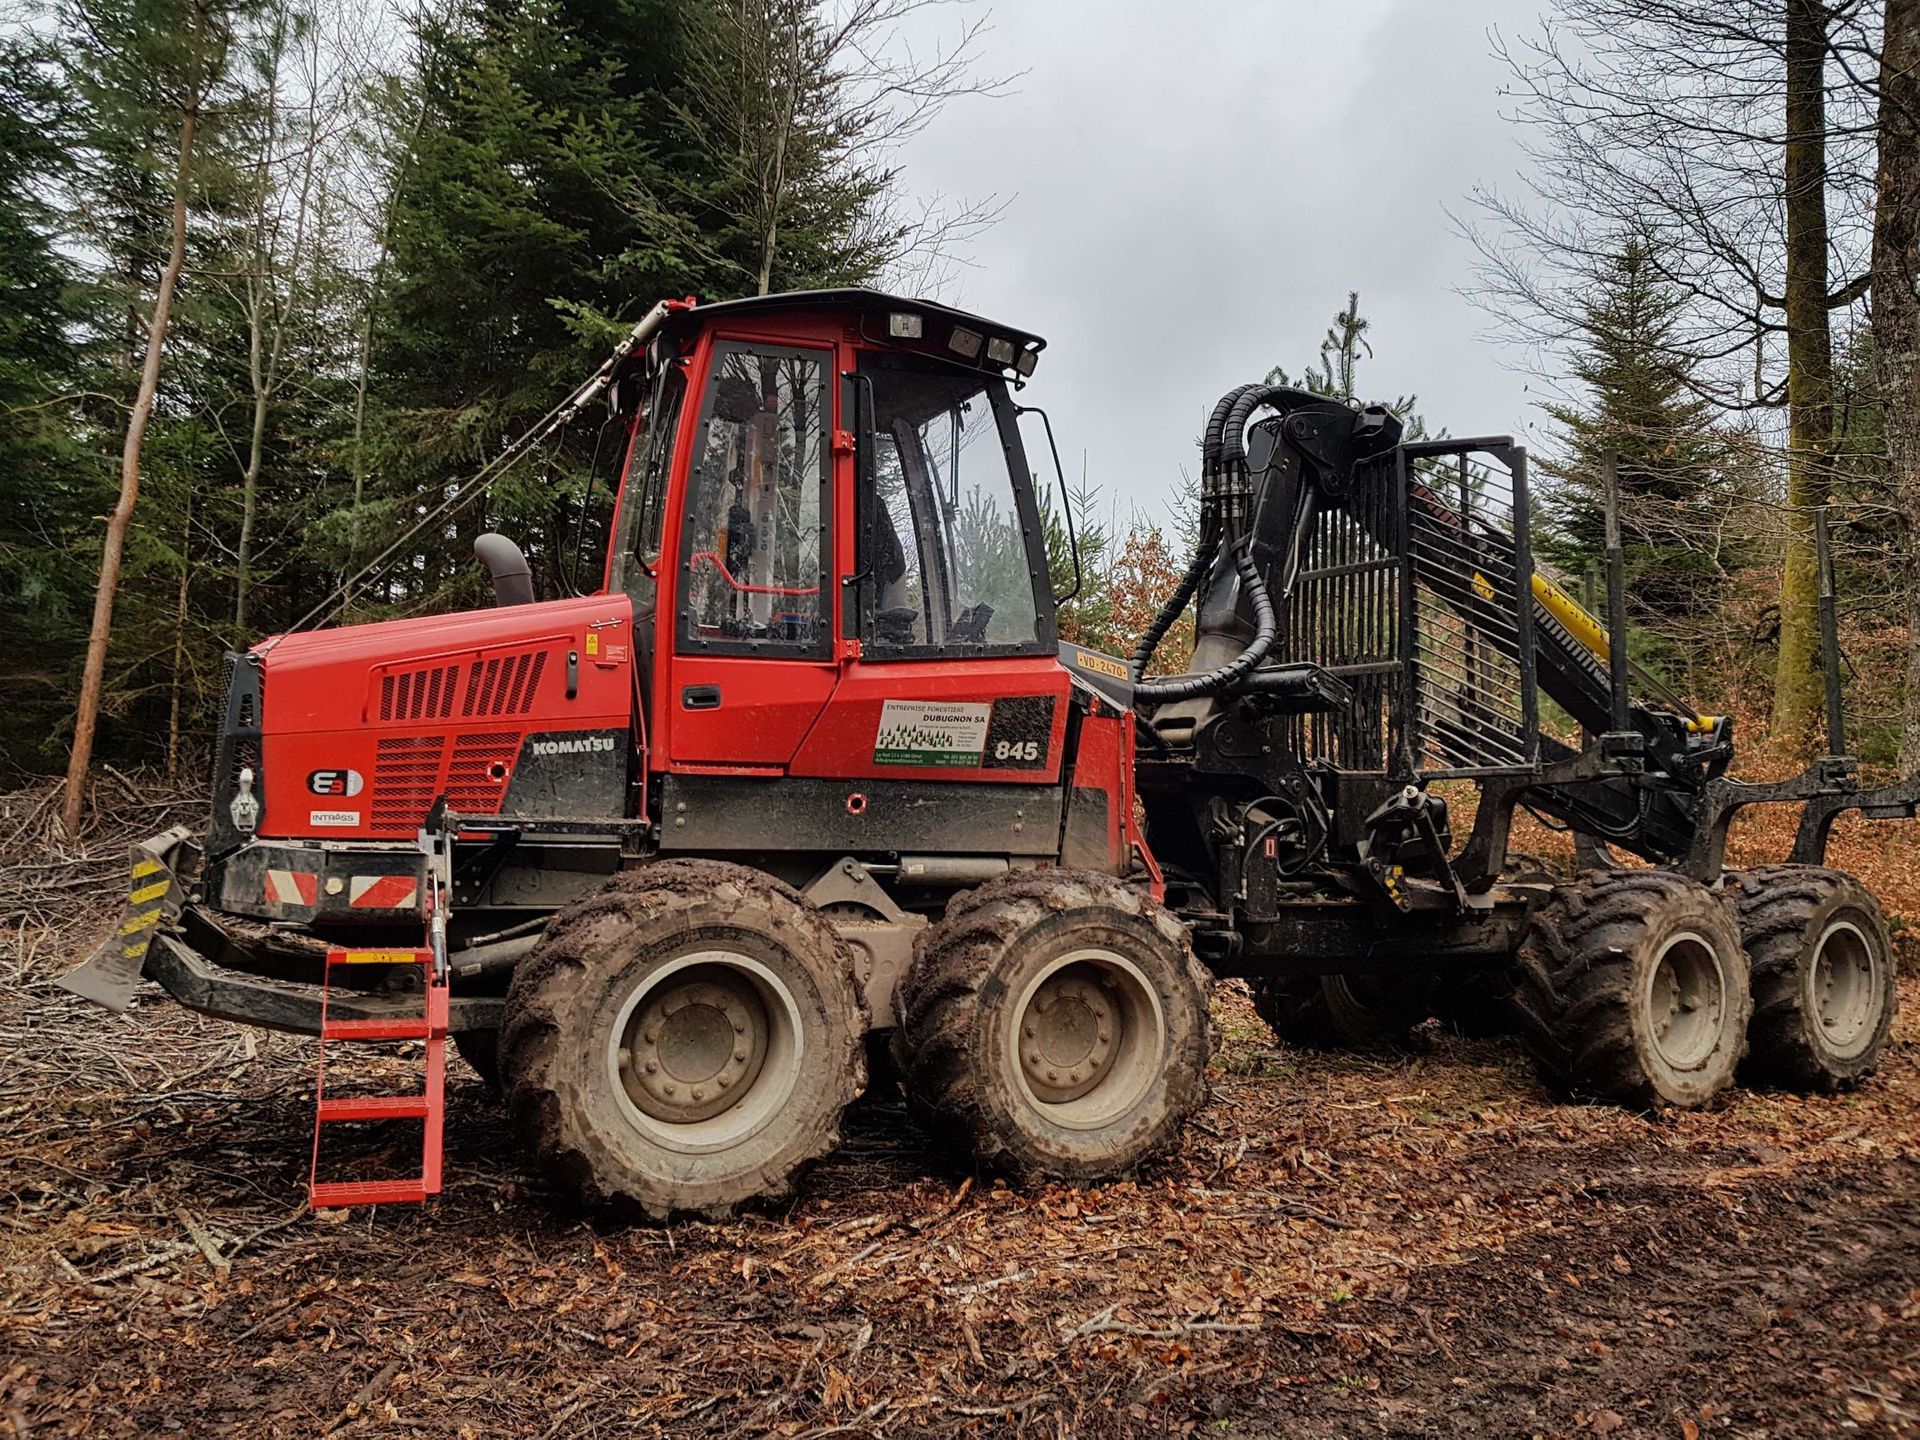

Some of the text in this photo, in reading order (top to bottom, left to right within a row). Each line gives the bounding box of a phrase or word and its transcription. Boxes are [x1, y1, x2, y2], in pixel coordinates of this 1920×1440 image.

[887, 704, 926, 712] ENTREPRISE
[922, 714, 985, 724] DUBUGNON SA
[532, 736, 614, 755] KOMATSU
[995, 741, 1038, 761] 845
